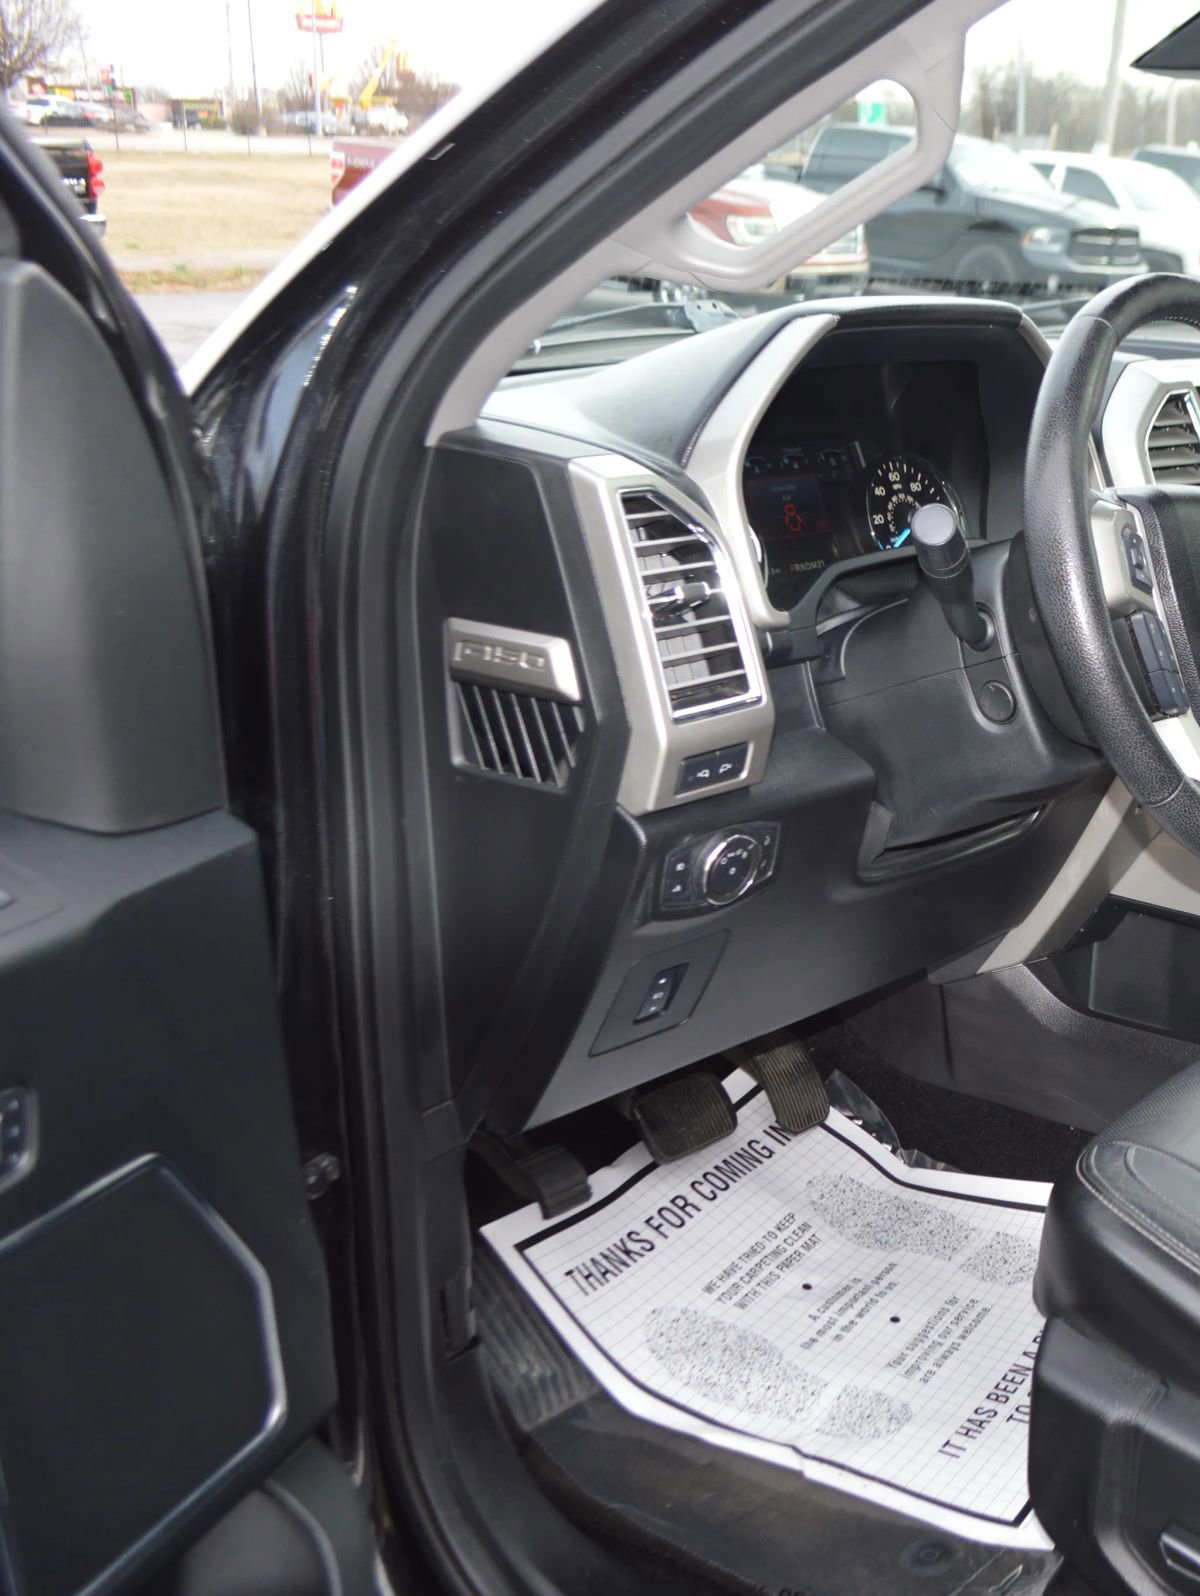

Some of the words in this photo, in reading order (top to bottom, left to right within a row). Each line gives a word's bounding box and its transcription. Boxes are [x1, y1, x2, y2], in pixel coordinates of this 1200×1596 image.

[874, 486, 886, 497] 40
[888, 471, 900, 482] 60
[910, 482, 922, 492] 80
[873, 514, 885, 525] 20
[564, 1230, 655, 1297] THANKS
[644, 1195, 702, 1240] FOR
[690, 1139, 776, 1202] COMING
[702, 1279, 720, 1295] WE
[716, 1261, 743, 1283] HAVE
[738, 1241, 766, 1263] TRIED
[762, 1230, 778, 1243] TO
[774, 1212, 796, 1233] KEEP
[716, 1282, 744, 1304] YOUR
[740, 1244, 787, 1285] CARPETING
[784, 1221, 812, 1247] CLEAN
[734, 1287, 761, 1310] WITH
[756, 1271, 781, 1291] THIS
[776, 1250, 805, 1273] PAPER
[801, 1233, 821, 1252] MAT
[800, 1337, 818, 1349] the
[816, 1316, 839, 1337] most
[832, 1284, 873, 1317] important
[870, 1262, 898, 1285] person
[808, 1313, 820, 1321] A
[817, 1284, 853, 1313] customer
[885, 1352, 908, 1368] Your
[905, 1306, 950, 1351] suggestions
[944, 1295, 960, 1306] for
[950, 1298, 978, 1326] service
[920, 1368, 936, 1384] are
[932, 1341, 961, 1369] always
[938, 1439, 967, 1459] IT
[955, 1406, 998, 1440] HAS
[986, 1363, 1034, 1405] BEEN
